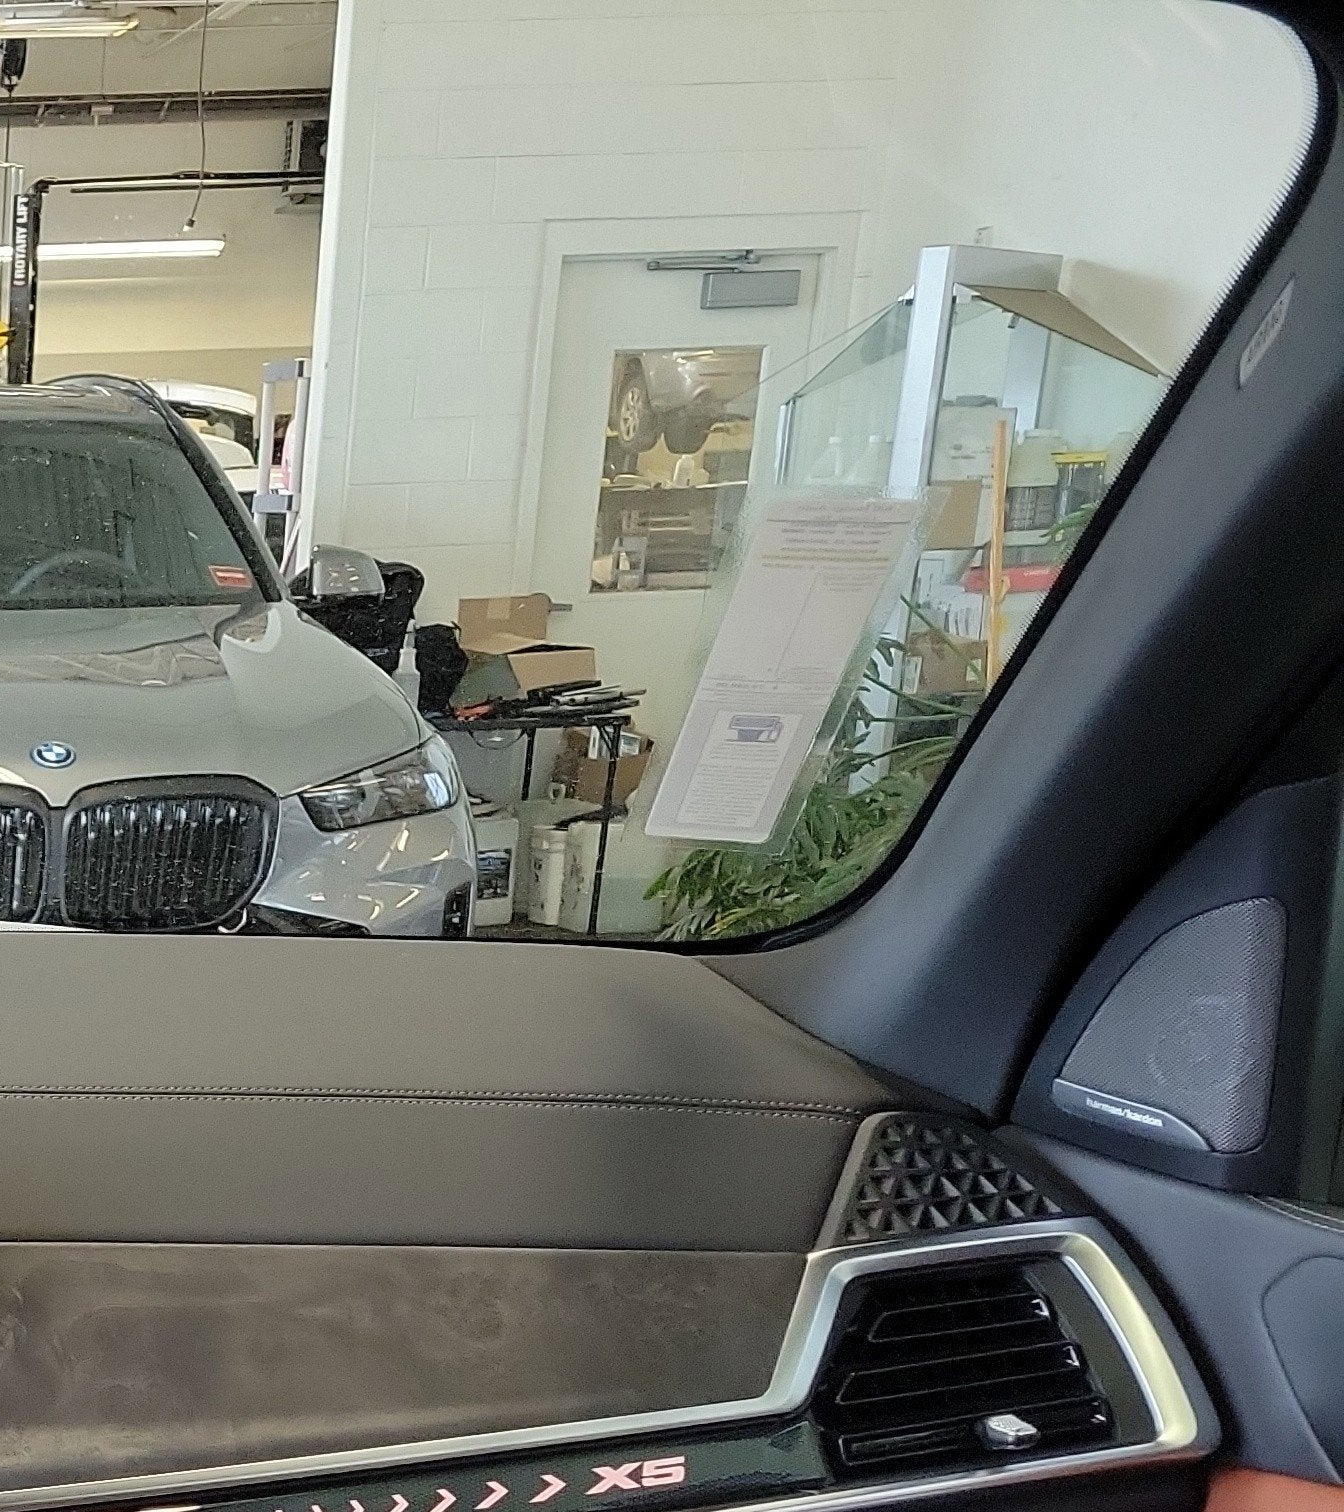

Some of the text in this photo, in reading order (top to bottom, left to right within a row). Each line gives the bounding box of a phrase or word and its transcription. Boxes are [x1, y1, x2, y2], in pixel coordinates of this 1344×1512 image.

[14, 196, 29, 279] ROTARY LIFT
[1086, 1097, 1163, 1127] harman/kardon
[585, 1456, 686, 1496] X5
